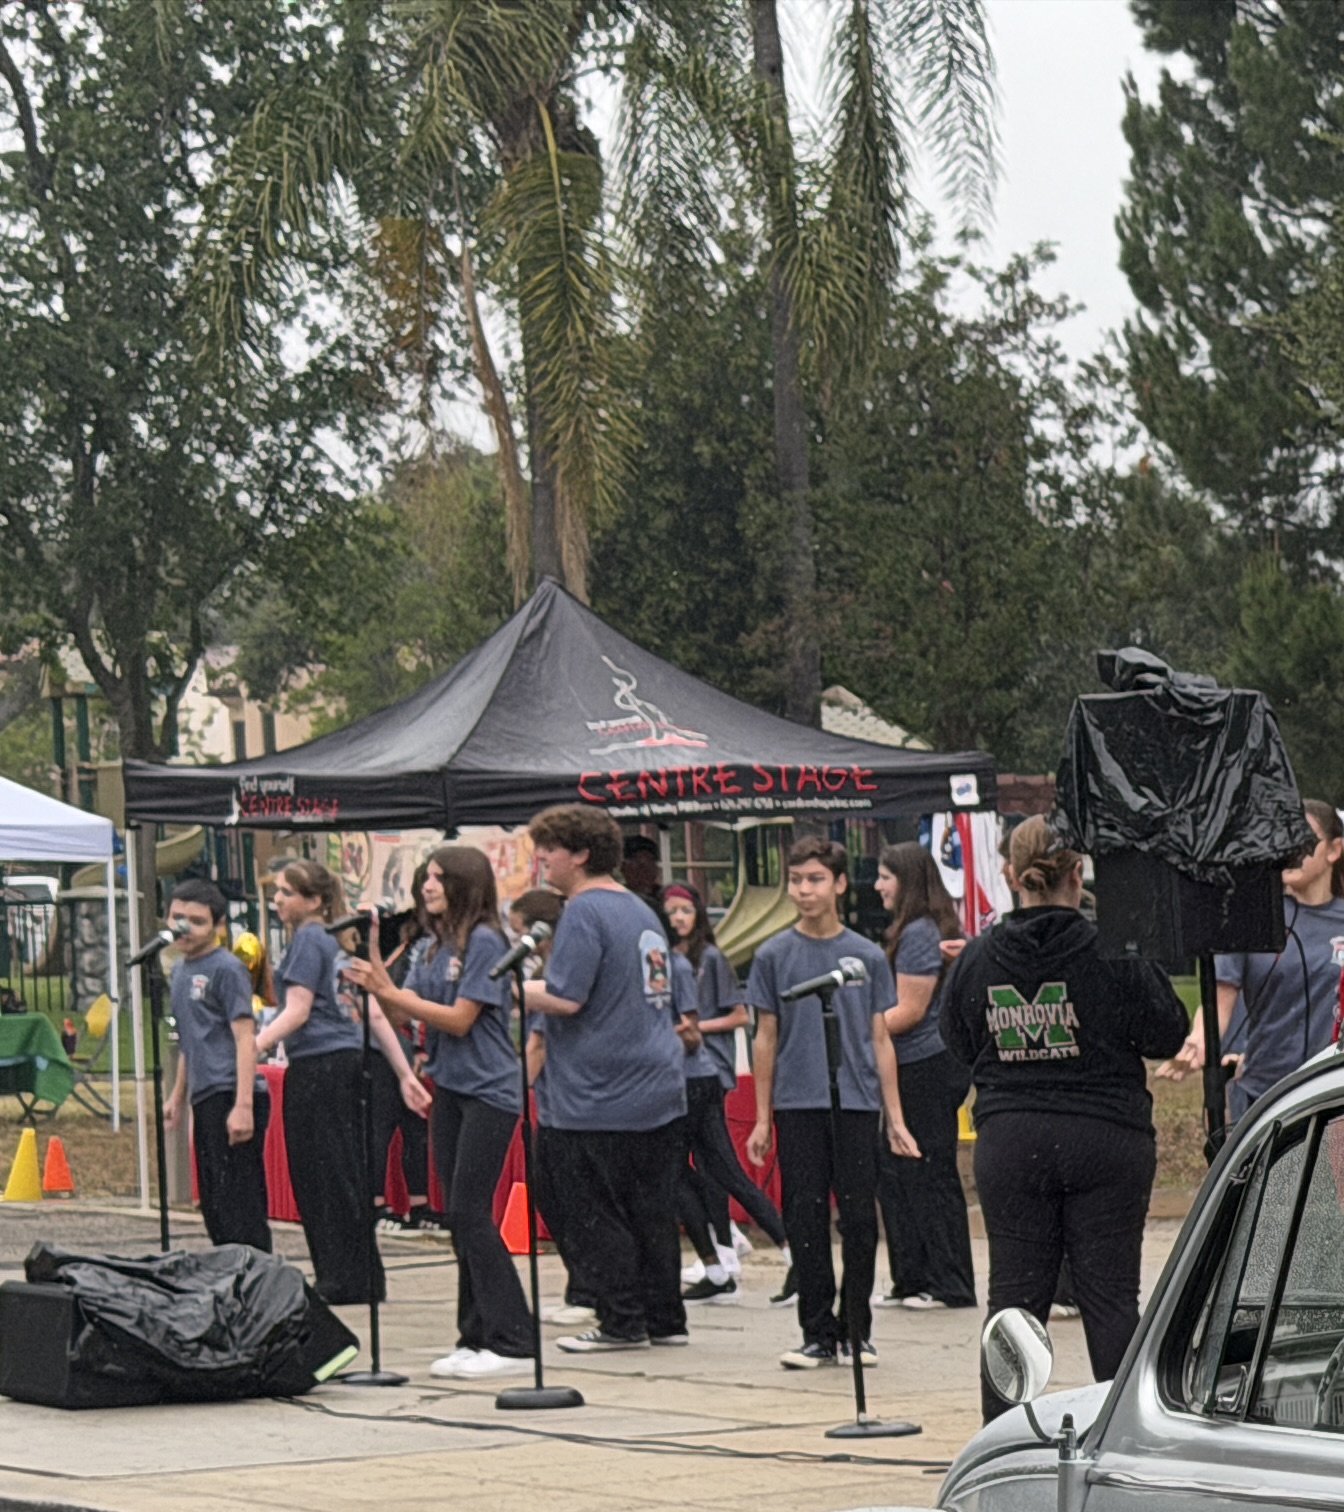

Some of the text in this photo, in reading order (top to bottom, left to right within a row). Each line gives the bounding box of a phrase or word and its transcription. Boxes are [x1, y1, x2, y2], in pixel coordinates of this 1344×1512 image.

[577, 761, 878, 801] CENTRE STAGE
[986, 1002, 1080, 1033] MONROVIA
[998, 1046, 1080, 1061] WILDCATS
